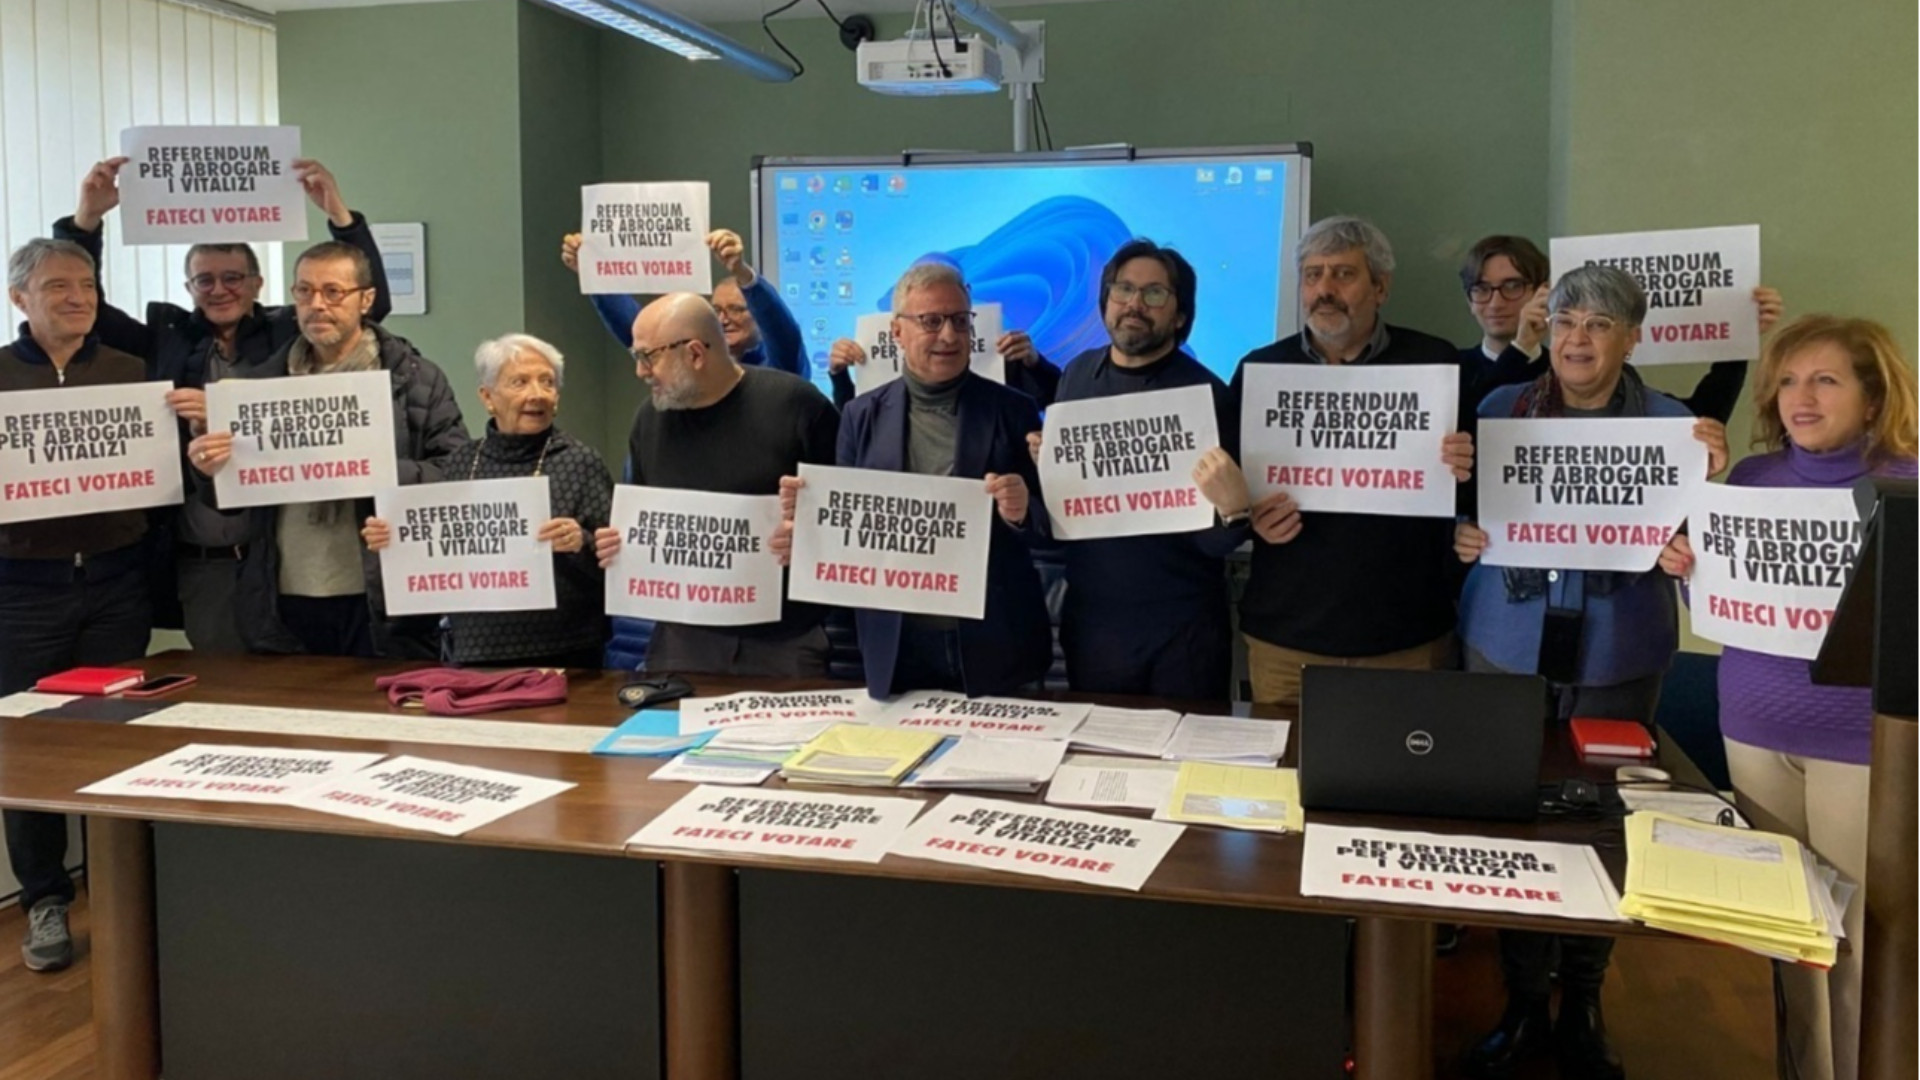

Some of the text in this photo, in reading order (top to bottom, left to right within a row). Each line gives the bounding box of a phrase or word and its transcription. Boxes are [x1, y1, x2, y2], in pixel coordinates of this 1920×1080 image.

[149, 146, 269, 162] REFERENDUM
[139, 161, 280, 178] PER ABROGARE
[169, 177, 255, 193] I VITALIZI
[147, 207, 281, 225] FATECI VOTARE
[597, 203, 683, 218] REFERENDUM
[591, 217, 691, 232] PER ABROGARE
[609, 233, 672, 247] I VITALIZI
[597, 261, 692, 275] FATECI VOTARE
[1636, 269, 1733, 290] BROGARE
[1651, 323, 1730, 342] VOTARE
[871, 345, 898, 359] PER
[239, 395, 359, 419] REFERENDUM
[1278, 391, 1419, 411] REFERENDUM
[5, 406, 142, 432] REFERENDUM
[230, 410, 370, 436] PER ABROGARE
[1060, 414, 1182, 445] REFERENDUM
[1266, 409, 1430, 430] PER ABROGARE
[45, 422, 154, 445] ABROGARE
[258, 429, 343, 451] I VITALIZI
[1296, 430, 1396, 449] I VITALIZI
[29, 440, 126, 464] I VITALIZI
[1054, 432, 1195, 464] PER ABROGARE
[1515, 446, 1665, 465] REFERENDUM
[239, 459, 370, 485] FATECI VOTARE
[1081, 454, 1170, 479] I VITALIZI
[1267, 466, 1424, 489] FATECI VOTARE
[1503, 465, 1678, 485] PER ABROGARE
[4, 470, 155, 500] FATECI VOTARE
[1536, 485, 1643, 505] I VITALIZI
[406, 502, 518, 524] REFERENDUM
[829, 491, 956, 520] REFERENDUM
[1064, 488, 1197, 516] FATECI VOTARE
[399, 519, 528, 542] PER ABROGARE
[638, 511, 750, 536] REFERENDUM
[818, 508, 966, 538] PER ABROGARE
[1507, 523, 1672, 545] FATECI VOTARE
[428, 538, 506, 557] I VITALIZI
[628, 527, 761, 552] PER ABROGARE
[844, 529, 935, 555] I VITALIZI
[1703, 532, 1857, 565] PER ABROGA
[651, 546, 732, 569] I VITALIZI
[1730, 559, 1736, 579] I
[408, 571, 529, 592] FATECI VOTARE
[816, 562, 959, 592] FATECI VOTARE
[628, 578, 756, 603] FATECI VOTARE
[1709, 595, 1775, 627] FATECI
[673, 826, 857, 849] FATECI VOTARE
[925, 837, 1116, 873] FATECI VOTARE
[1342, 873, 1563, 903] FATECI VOTARE
